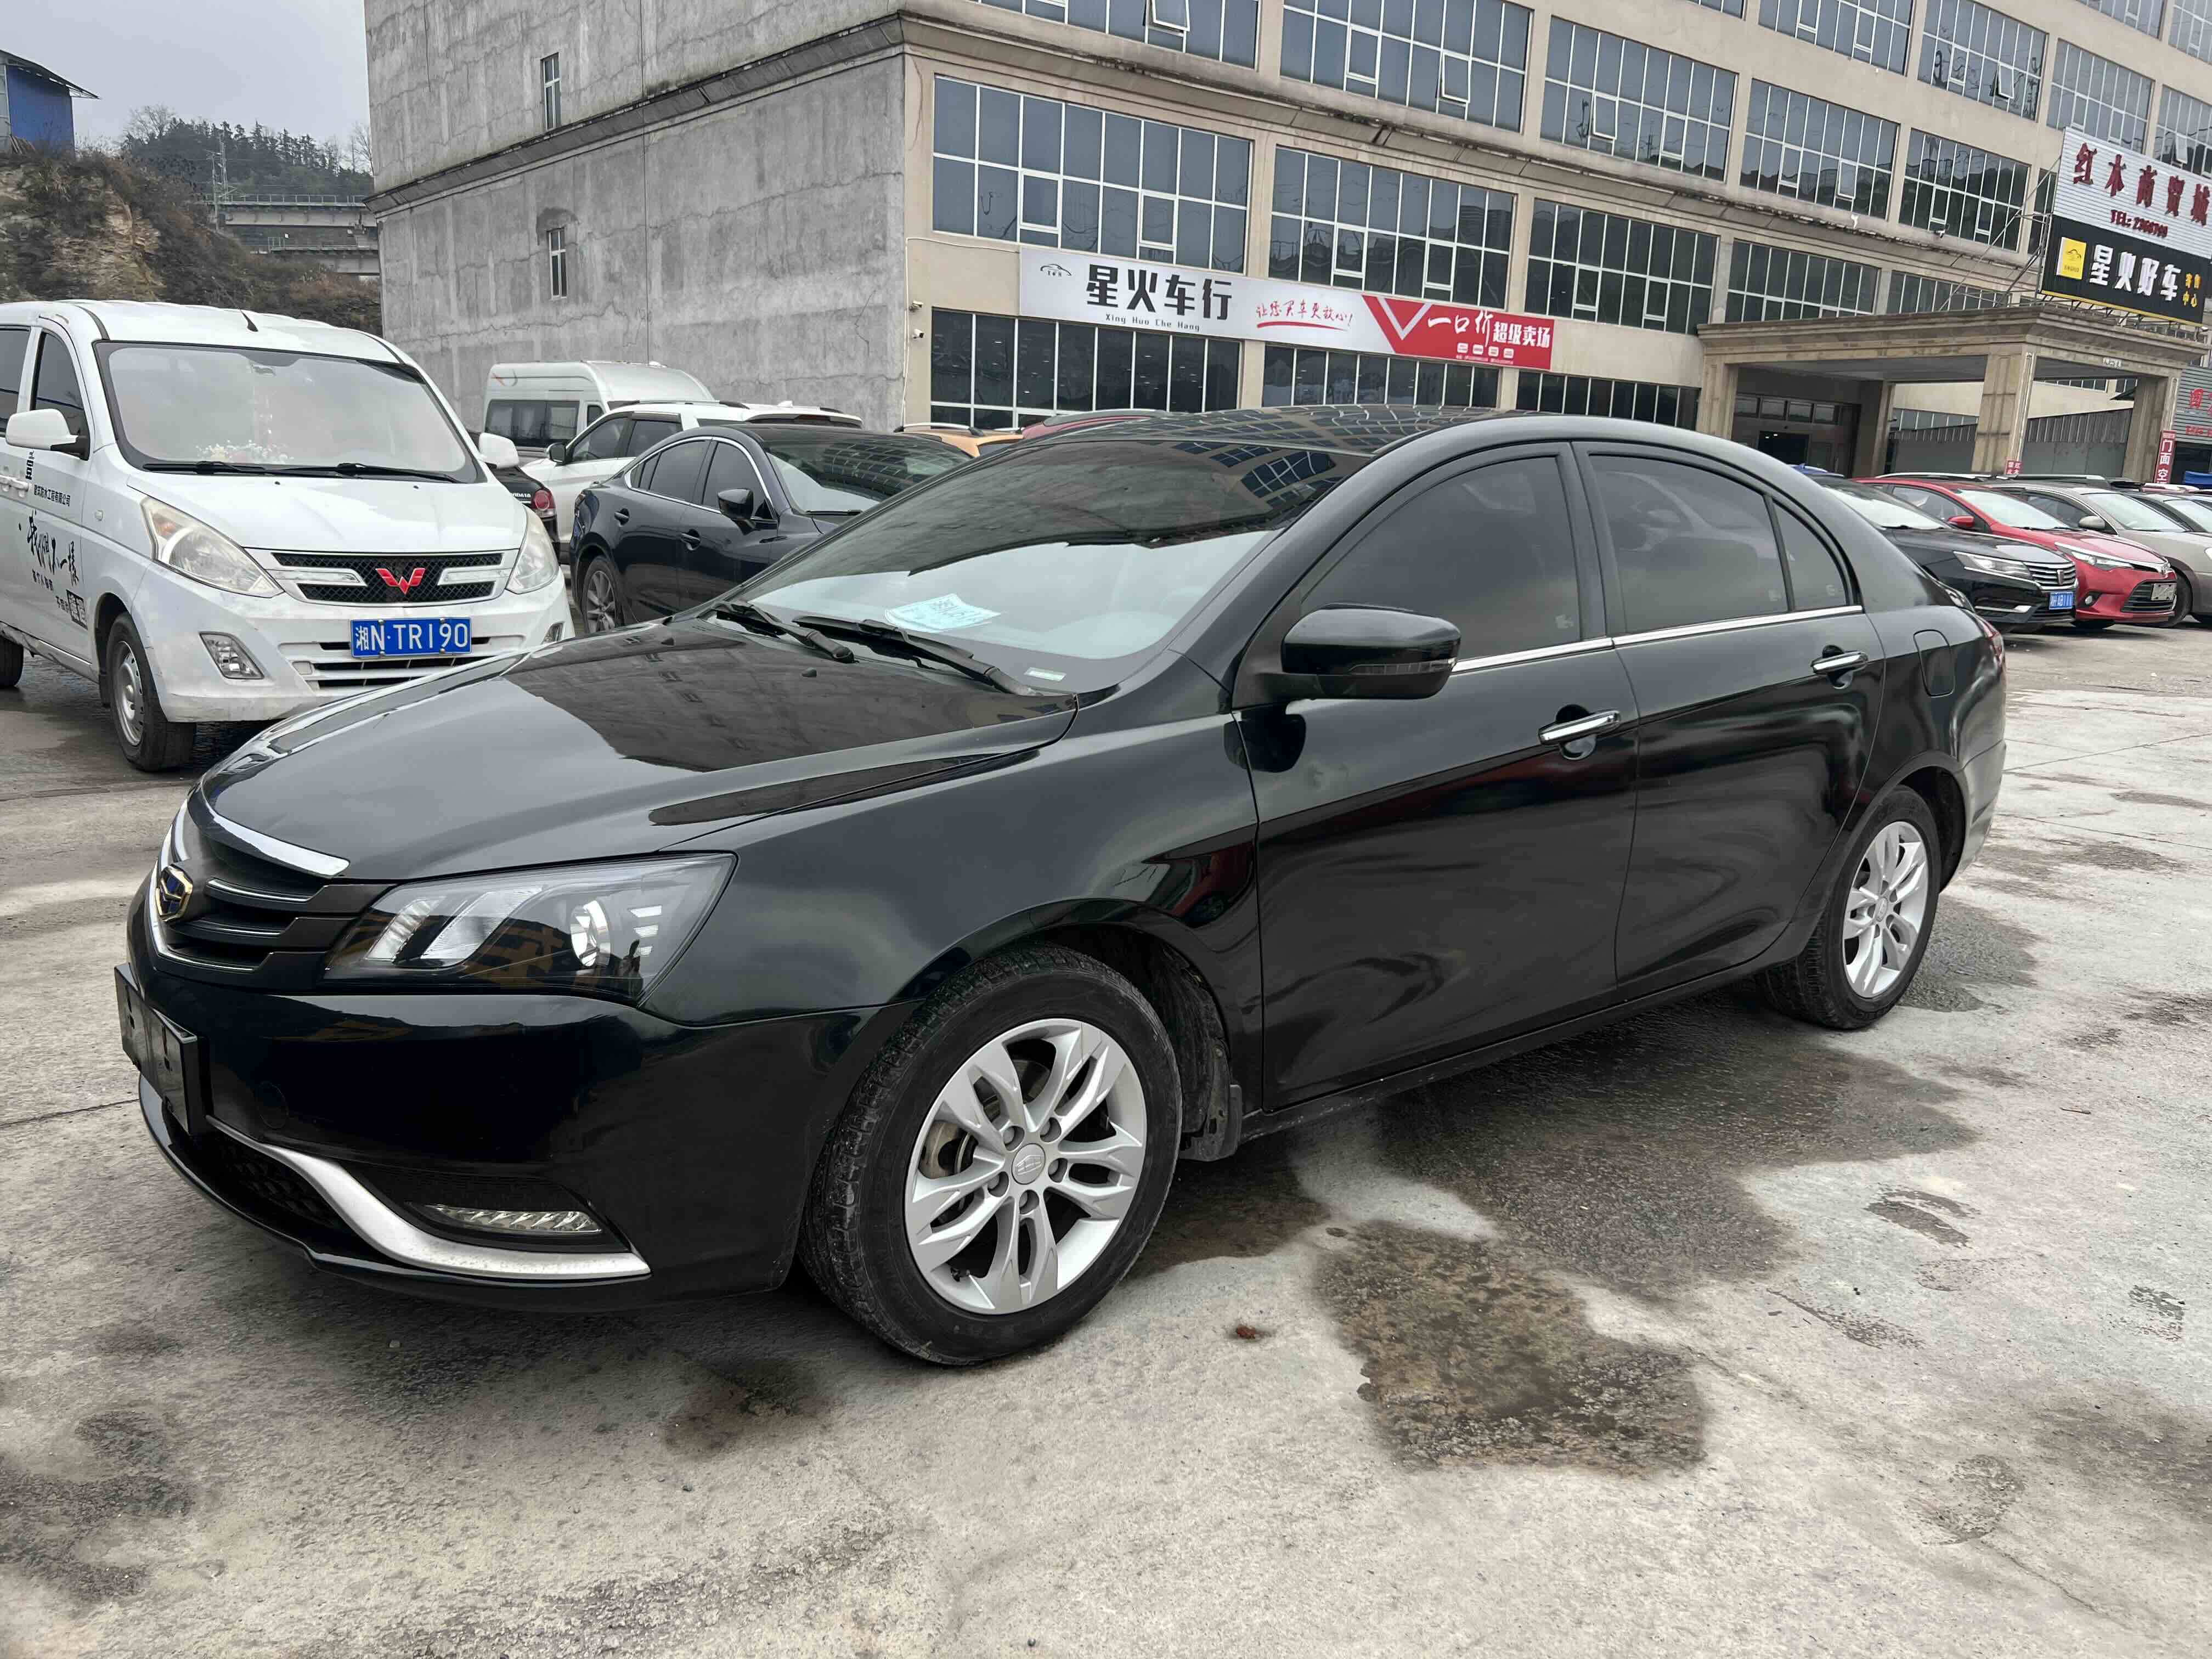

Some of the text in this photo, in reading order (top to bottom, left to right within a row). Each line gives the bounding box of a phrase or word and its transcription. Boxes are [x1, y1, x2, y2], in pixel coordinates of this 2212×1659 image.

[1086, 263, 1232, 320] 星火车行
[2089, 244, 2182, 301] 星火好车
[1105, 313, 1200, 332] Xing Huo Che Hang
[1492, 321, 1551, 348] 超级卖场
